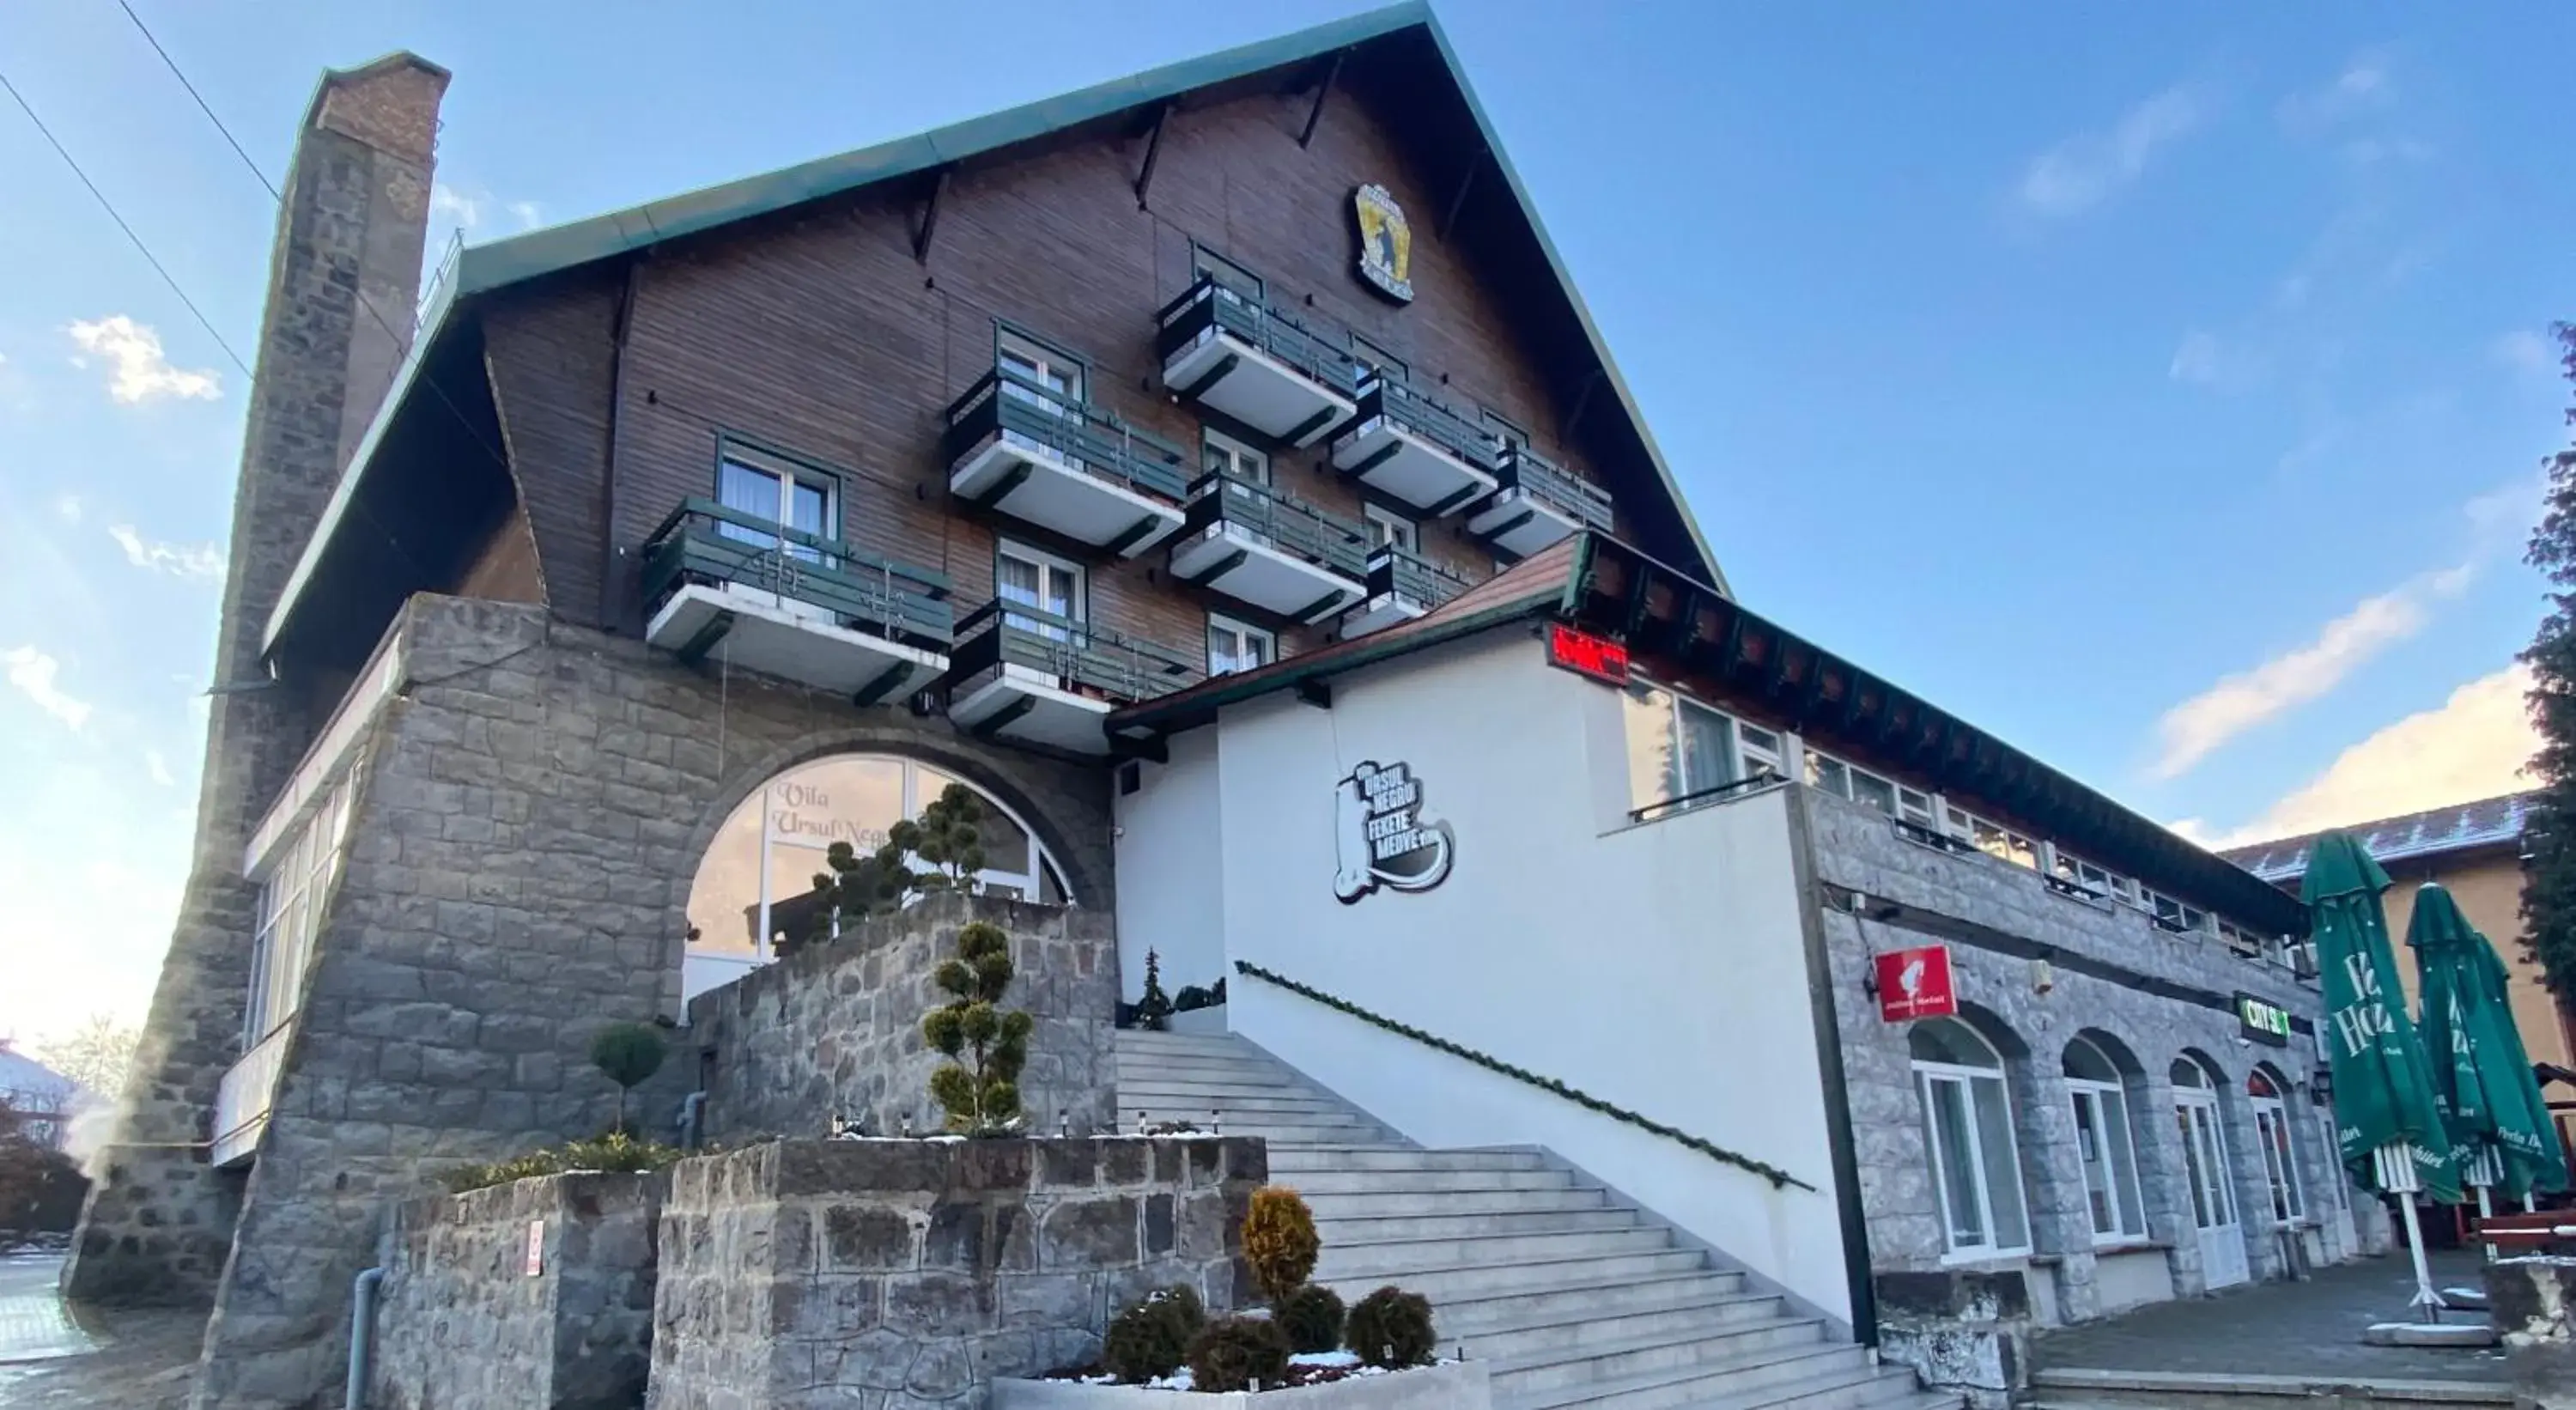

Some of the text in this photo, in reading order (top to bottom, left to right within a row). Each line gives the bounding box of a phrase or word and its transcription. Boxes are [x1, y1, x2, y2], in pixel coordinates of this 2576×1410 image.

[776, 782, 829, 808] Vila
[772, 811, 836, 839] Ursul
[1368, 809, 1412, 842] FEKETE
[1376, 828, 1420, 860] MEDVE
